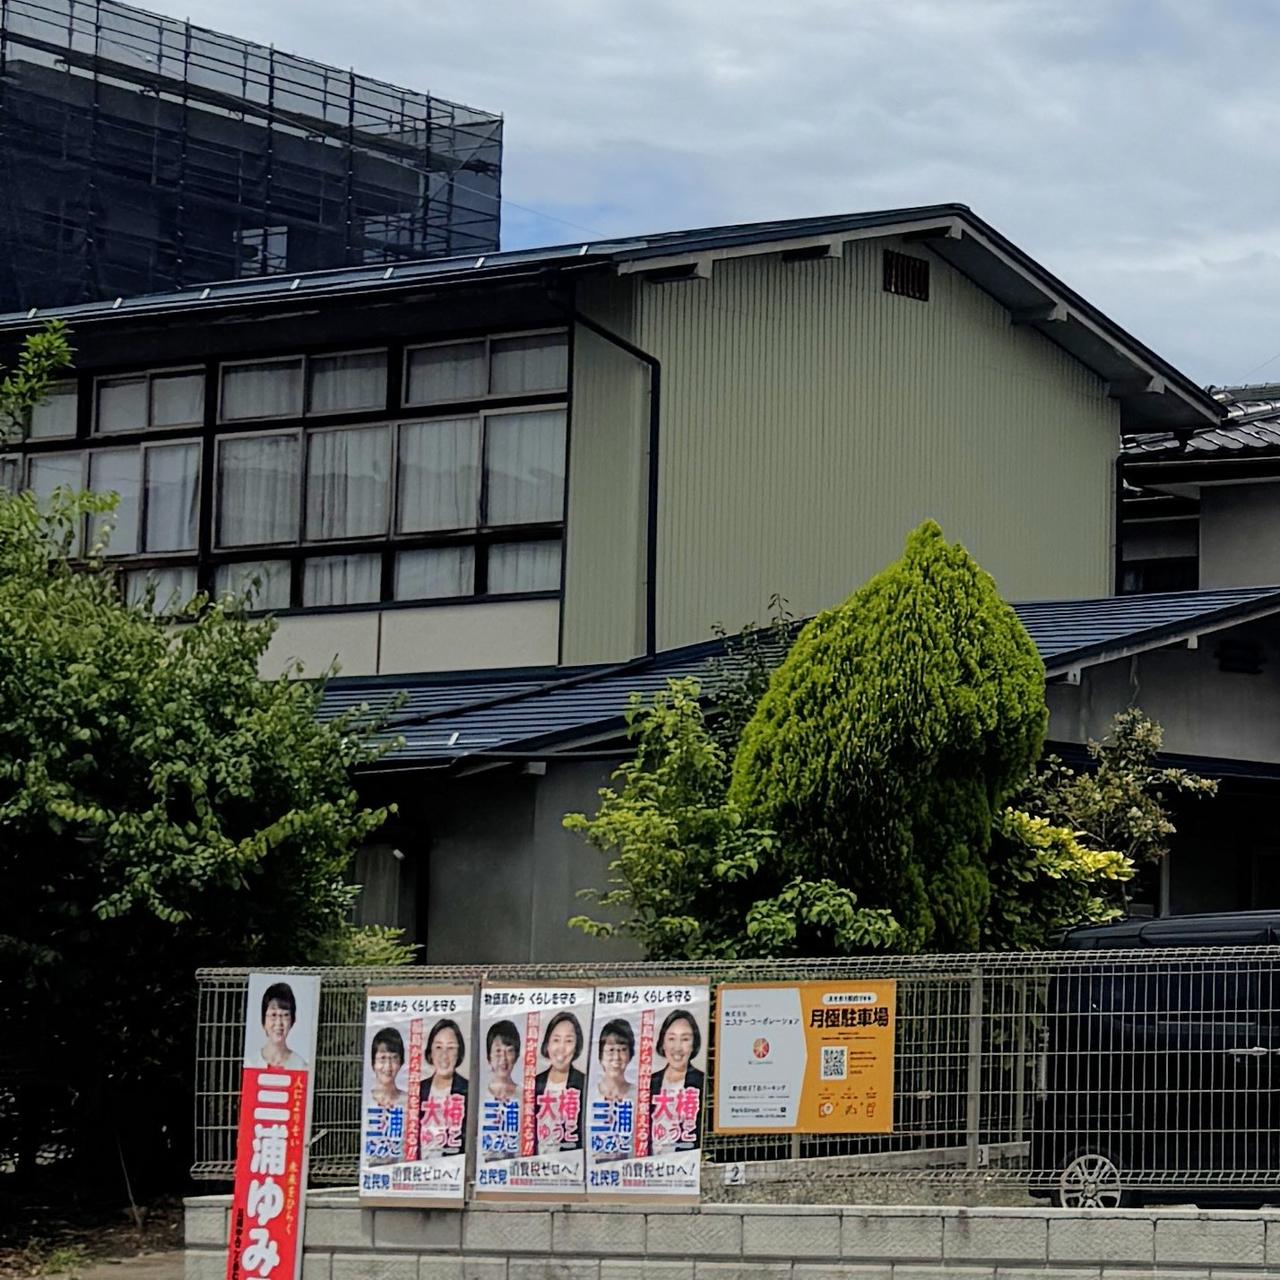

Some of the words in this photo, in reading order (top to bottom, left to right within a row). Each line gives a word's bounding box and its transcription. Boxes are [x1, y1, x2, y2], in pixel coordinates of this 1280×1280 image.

[810, 1007, 889, 1028] 月極駐車場
[421, 1093, 466, 1127] 大椿
[537, 1088, 581, 1121] 大椿
[653, 1089, 699, 1122] 大椿
[366, 1107, 404, 1138] 三浦
[482, 1101, 519, 1133] 三浦
[591, 1101, 633, 1133] 三浦
[421, 1129, 463, 1148] ゆうこ
[482, 1134, 518, 1152] ゆみこ
[537, 1124, 579, 1142] ゆうこ
[653, 1124, 697, 1142] ゆうこ
[366, 1139, 402, 1157] ゆみこ
[591, 1135, 631, 1153] ゆみこ
[730, 1166, 739, 1183] 2
